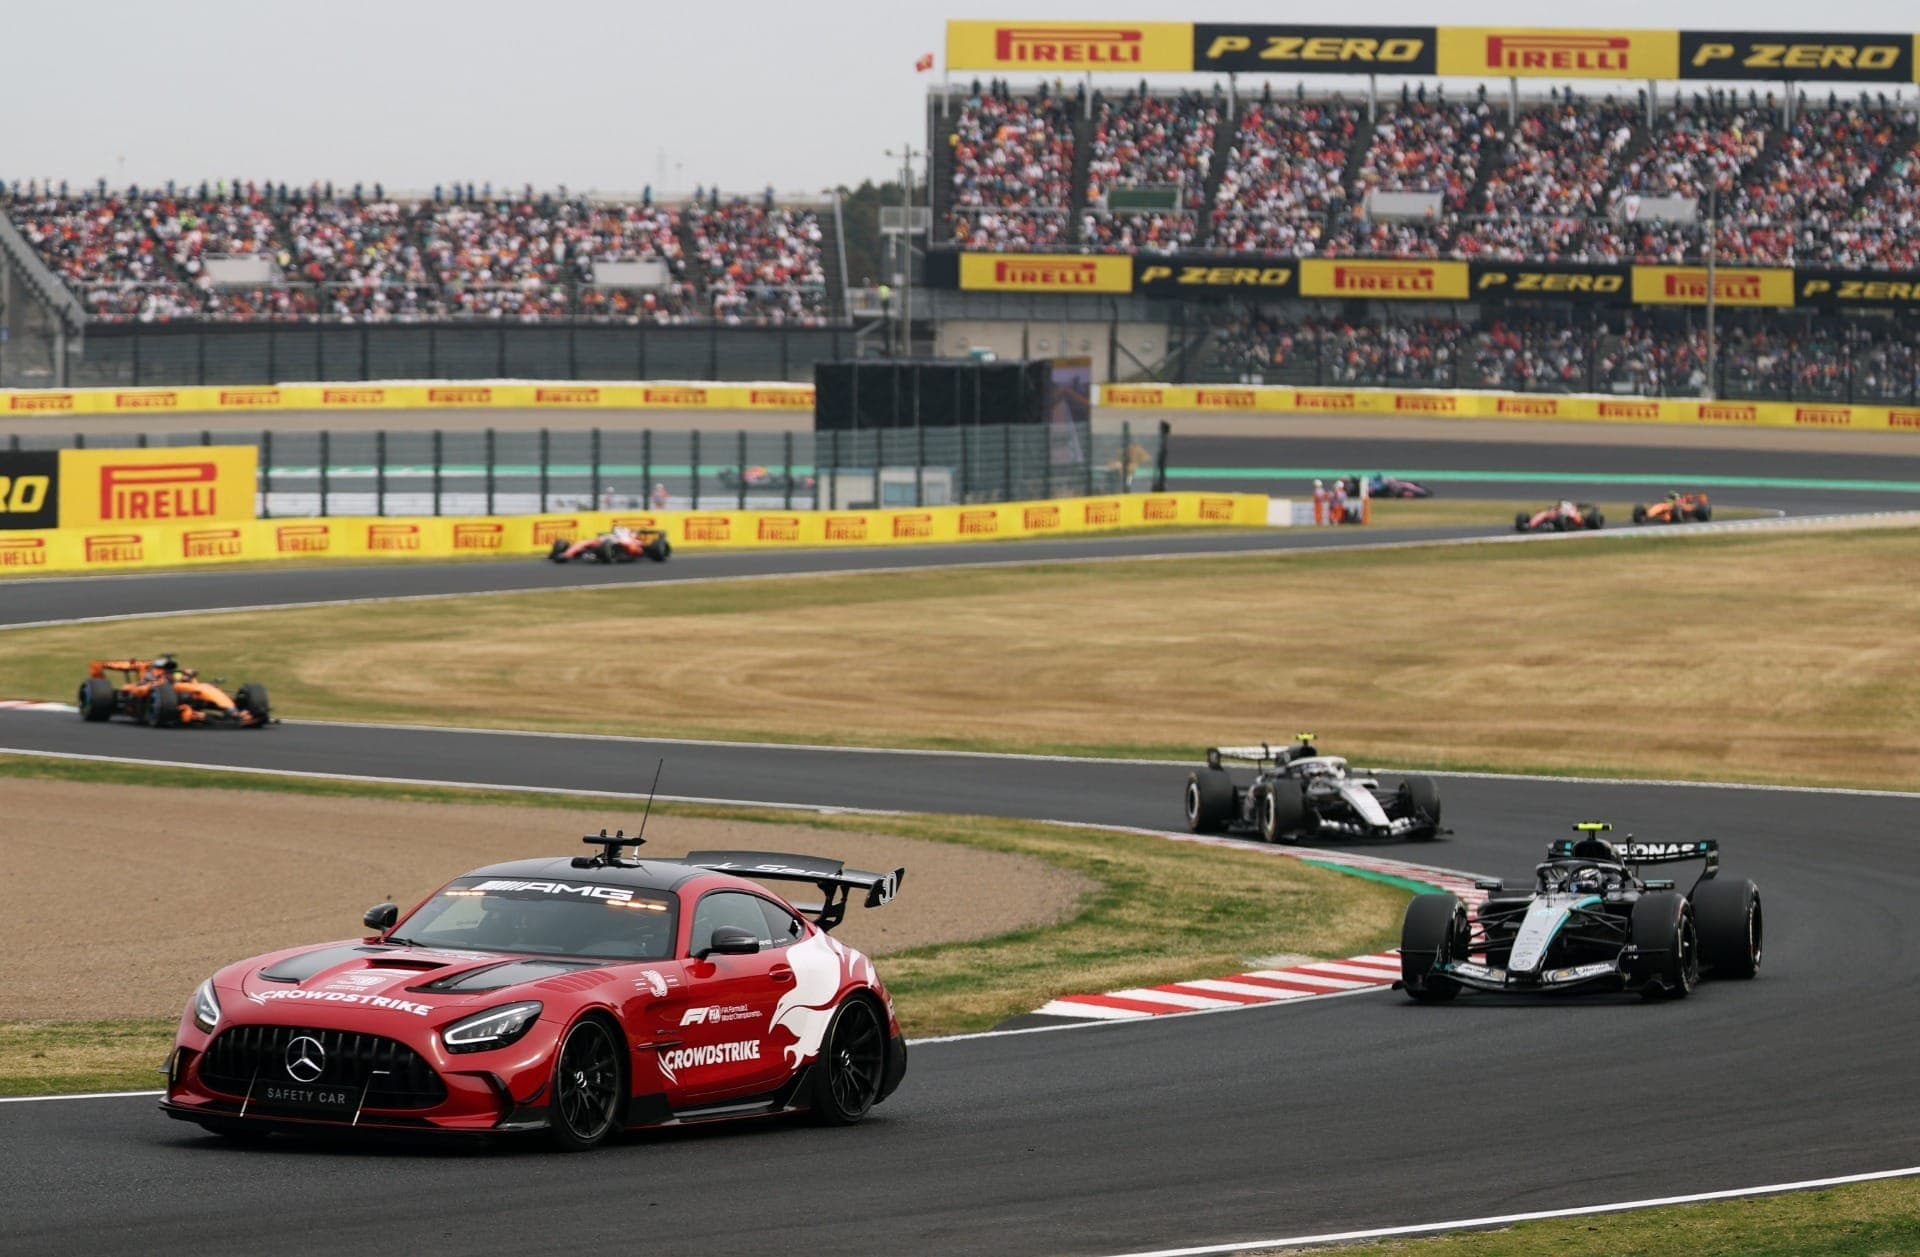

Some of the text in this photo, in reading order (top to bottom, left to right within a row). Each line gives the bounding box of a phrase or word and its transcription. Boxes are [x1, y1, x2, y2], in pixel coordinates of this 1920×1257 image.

[995, 29, 1142, 62] PIRELLI
[1206, 36, 1423, 61] P ZERO
[1487, 35, 1630, 70] PIRELLI
[1692, 44, 1900, 69] P ZERO
[995, 260, 1096, 284] PIRELLI
[1141, 266, 1291, 285] P ZERO
[1334, 266, 1434, 291] PIRELLI
[1478, 273, 1623, 292] P ZERO
[1803, 280, 1830, 297] P
[100, 462, 217, 520] PIRELLI
[83, 533, 143, 563] PIRELLI
[181, 528, 241, 558] PIRELLI
[275, 524, 330, 552] PIRELLI
[367, 525, 420, 550] PIRELLI
[452, 523, 505, 549] PIRELLI
[515, 881, 634, 902] AMG
[257, 989, 435, 1017] CROWDSTRIKE
[679, 1006, 709, 1026] F1
[663, 1039, 761, 1071] CROWDSTRIKE
[267, 1087, 345, 1104] SAFETY CAR
